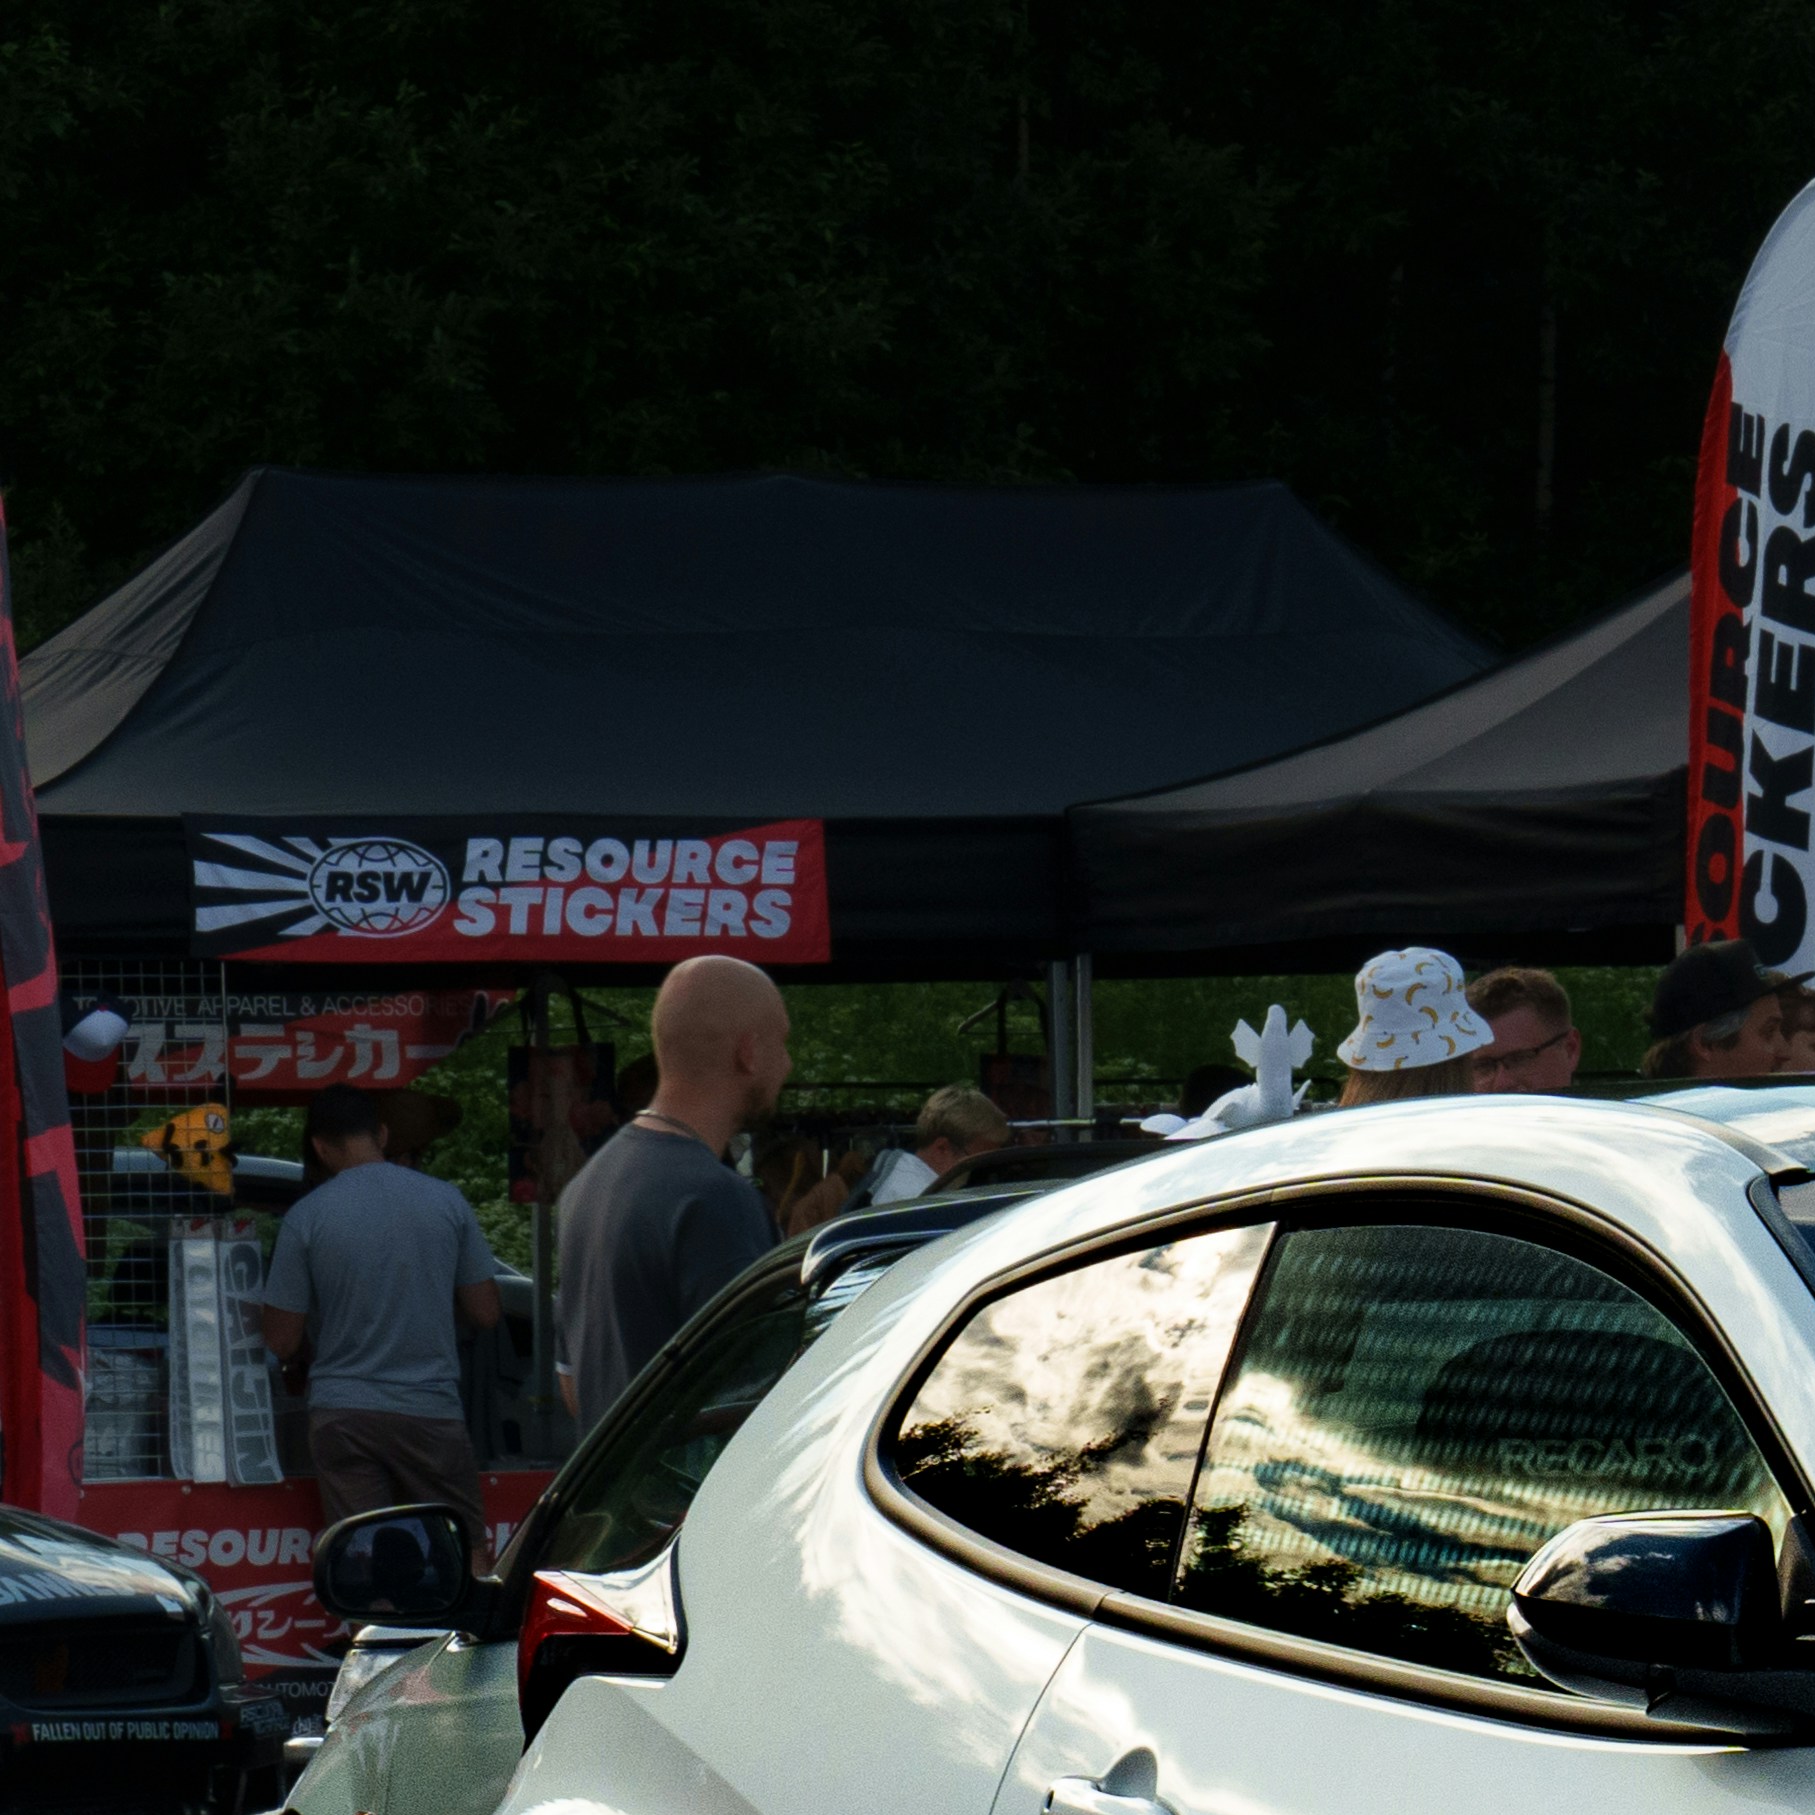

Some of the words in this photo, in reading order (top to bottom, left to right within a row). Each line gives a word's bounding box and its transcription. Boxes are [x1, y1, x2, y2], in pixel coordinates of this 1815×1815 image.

[1690, 401, 1765, 945] OURCE
[461, 836, 799, 886] RESOURCE
[324, 870, 433, 904] RSW
[452, 886, 793, 940] STICKERS
[197, 995, 294, 1017] APPAREL
[300, 995, 317, 1017] &
[32, 1722, 81, 1742] FALLEN
[83, 1722, 107, 1742] OUT
[108, 1722, 124, 1741] OF
[127, 1722, 169, 1741] PUBLIC
[172, 1721, 220, 1740] OPINION
